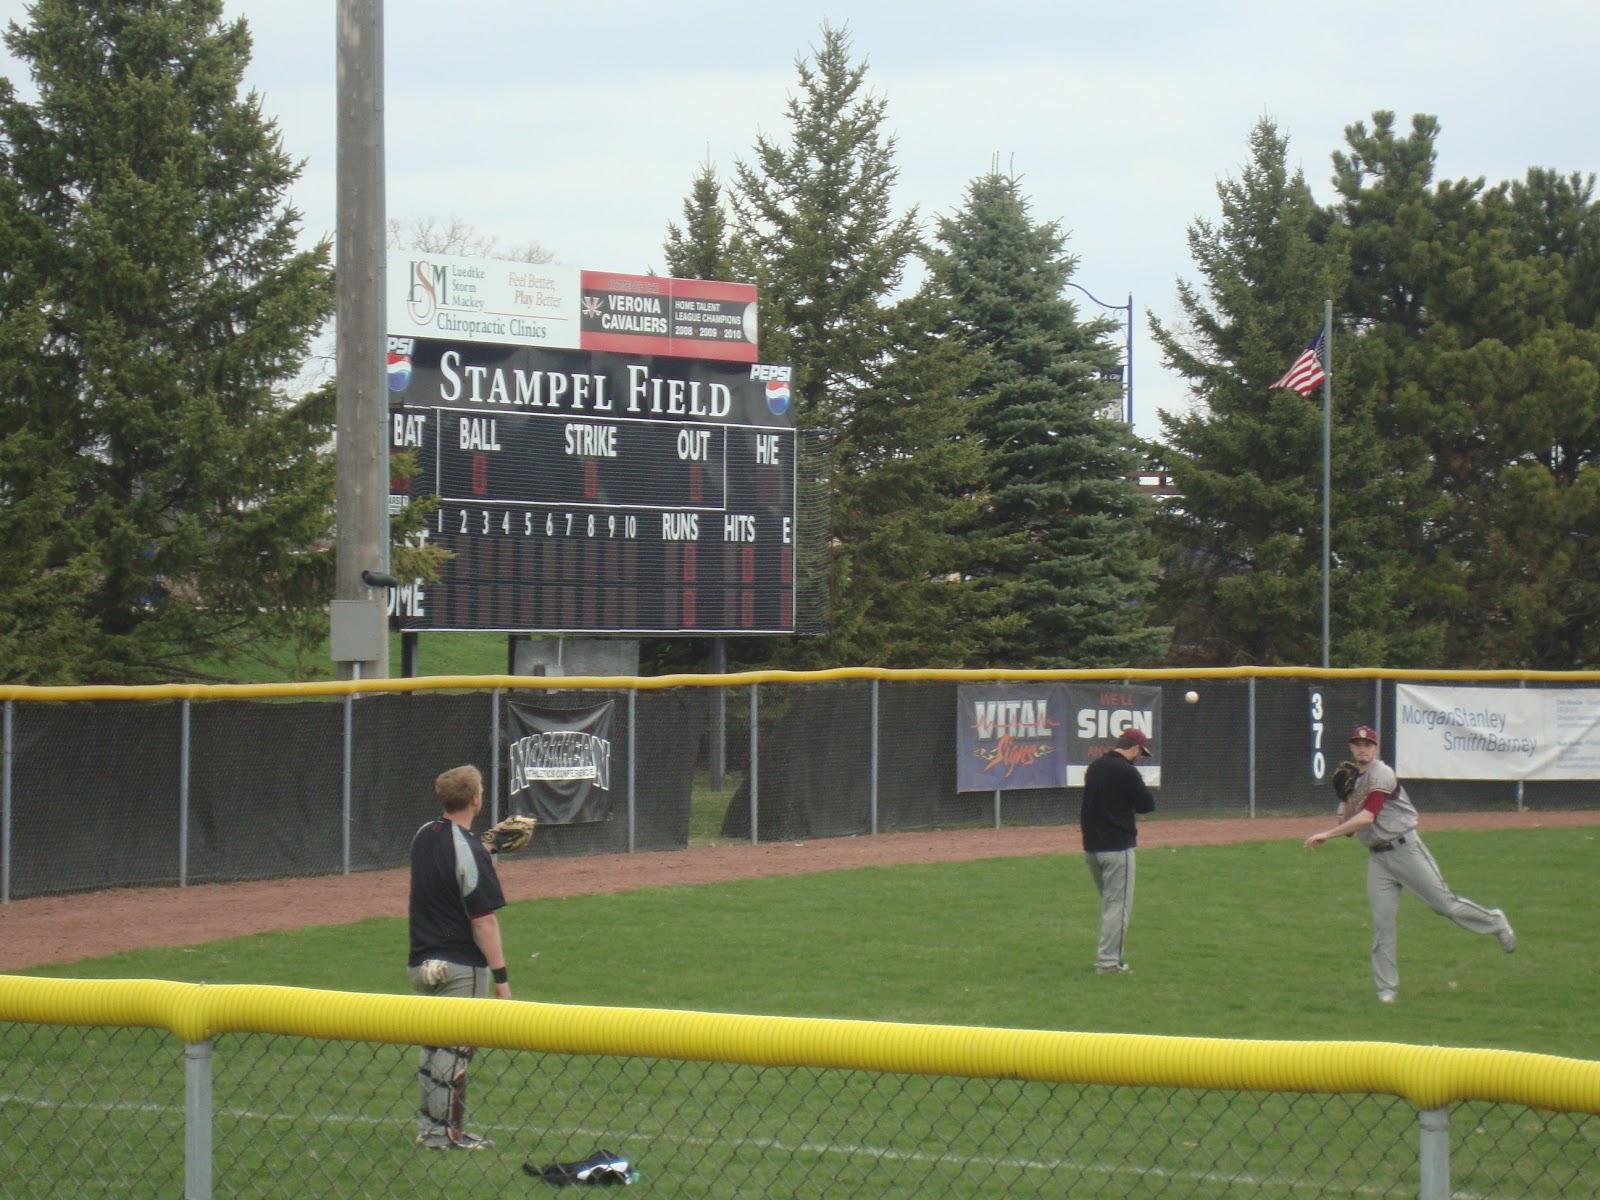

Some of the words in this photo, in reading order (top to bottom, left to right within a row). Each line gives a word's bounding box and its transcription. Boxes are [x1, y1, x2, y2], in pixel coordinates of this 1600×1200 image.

[451, 264, 485, 279] Luedtke
[508, 272, 527, 287] Feel
[451, 279, 477, 293] Storm
[451, 296, 485, 312] Mackey
[513, 290, 533, 308] Play
[537, 292, 562, 308] Better
[608, 294, 661, 314] VERONA
[675, 300, 695, 311] HOME
[696, 302, 720, 312] TALENT
[437, 312, 506, 336] Chiropractic
[509, 318, 547, 338] Clinics
[601, 313, 668, 334] CAVALIERS
[675, 312, 701, 323] LEAGUE
[702, 313, 742, 325] CHAMPIONS
[675, 325, 693, 336] 2008
[699, 327, 718, 338] 2009
[724, 329, 742, 339] 2010
[387, 337, 415, 355] PSI
[750, 364, 792, 382] PEPSI
[440, 350, 612, 411] STAMPFL
[627, 365, 731, 417] FIELD
[393, 414, 426, 448] BAT
[459, 417, 501, 451] BALL
[564, 423, 618, 457] STRIKE
[677, 429, 711, 461] OUT
[437, 508, 443, 533] 1
[460, 509, 468, 534] 2
[482, 510, 490, 535] 3
[502, 511, 510, 535] 4
[524, 512, 532, 536] 5
[546, 512, 554, 537] 6
[565, 513, 573, 536] 7
[587, 514, 595, 537] 8
[608, 514, 616, 538] 9
[624, 515, 637, 539] 10
[662, 512, 699, 541] RUNS
[723, 514, 756, 543] HITS
[783, 516, 791, 544] E
[974, 699, 1053, 739] VITAL
[1077, 708, 1153, 739] SIGN
